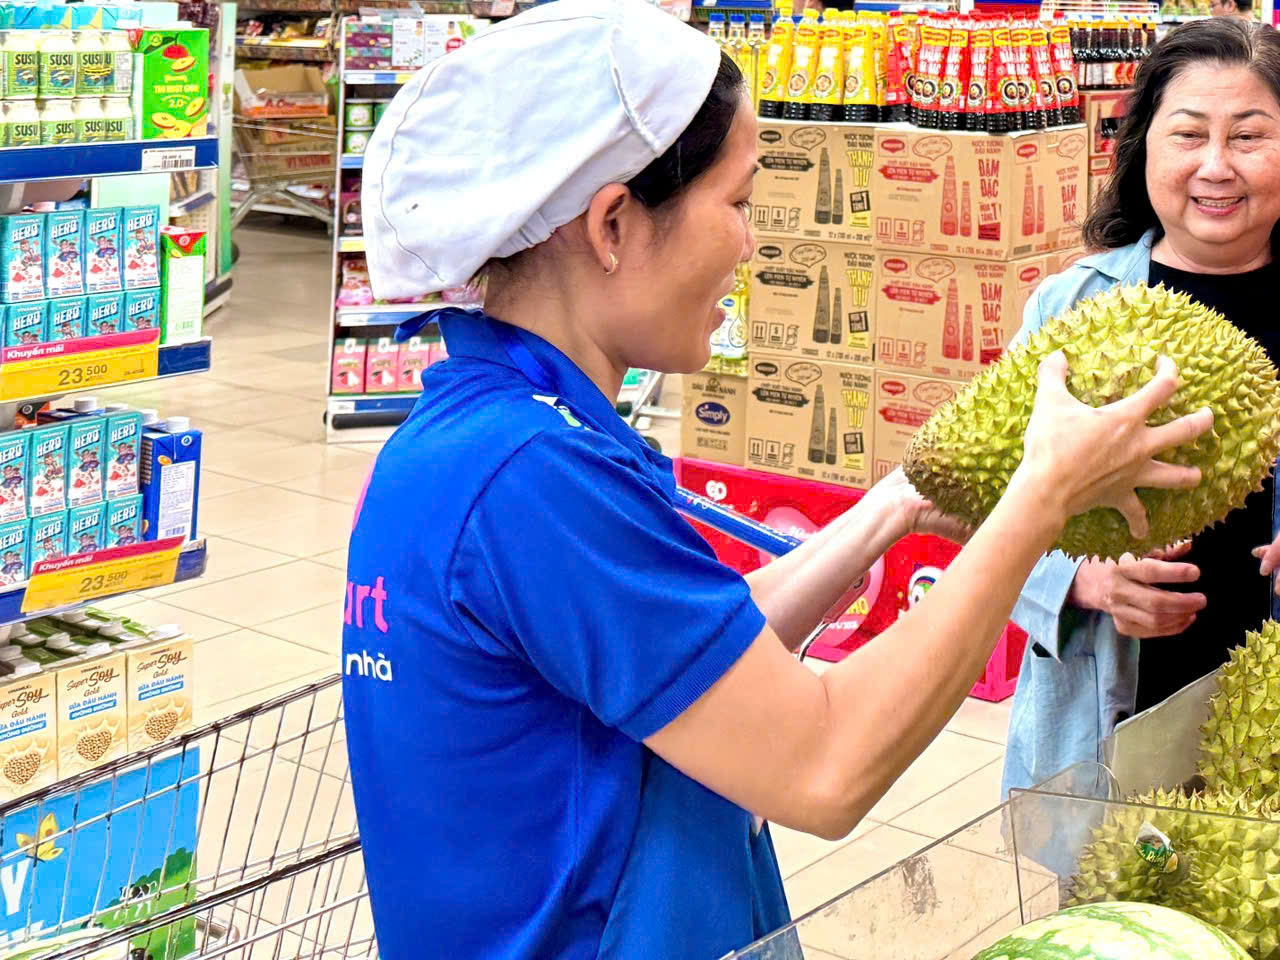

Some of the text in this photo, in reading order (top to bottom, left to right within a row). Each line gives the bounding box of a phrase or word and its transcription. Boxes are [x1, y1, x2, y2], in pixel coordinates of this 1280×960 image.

[12, 223, 39, 242] HERO
[51, 220, 78, 239] HERO
[89, 217, 116, 235] HERO
[127, 214, 154, 232] HERO
[92, 302, 118, 321] HERO
[128, 296, 153, 316] HERO
[13, 311, 40, 330] HERO
[54, 307, 80, 326] HERO
[7, 347, 44, 360] Khuyến
[697, 404, 728, 424] Simply
[74, 430, 100, 449] HERO
[111, 423, 136, 442] HERO
[36, 436, 62, 456] HERO
[72, 514, 99, 533] HERO
[110, 506, 136, 524] HERO
[35, 521, 62, 542] HERO
[39, 556, 75, 572] Khuyến
[136, 659, 158, 673] Super
[152, 668, 169, 679] Gold
[345, 649, 393, 682] nhà
[66, 678, 88, 692] Super
[83, 686, 100, 697] Gold
[11, 707, 29, 719] Gold
